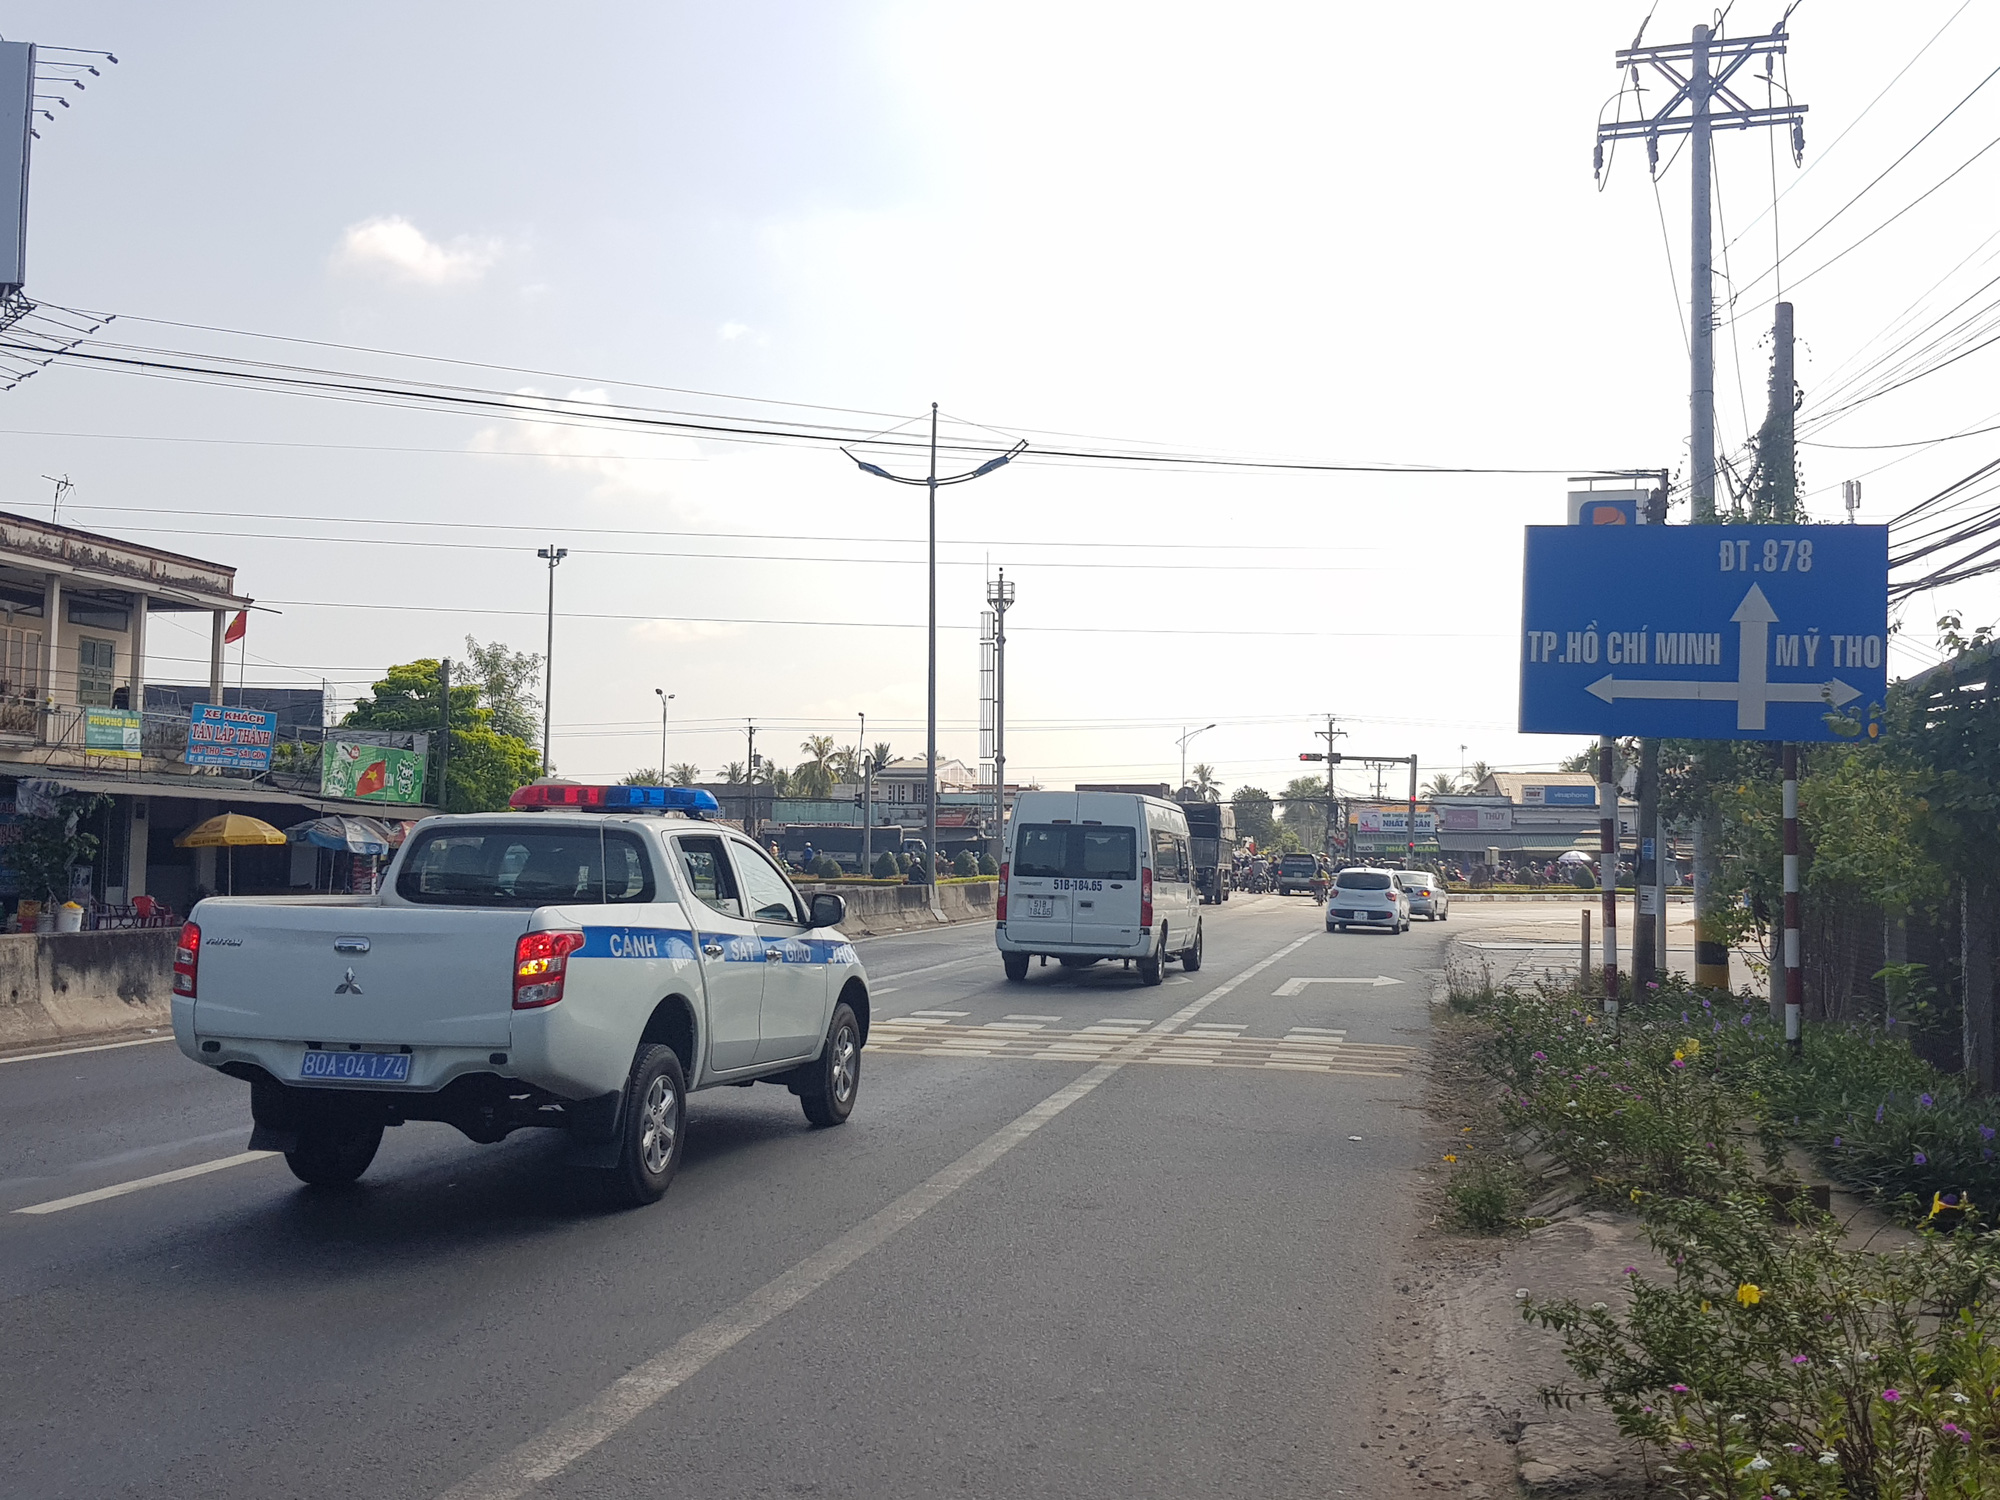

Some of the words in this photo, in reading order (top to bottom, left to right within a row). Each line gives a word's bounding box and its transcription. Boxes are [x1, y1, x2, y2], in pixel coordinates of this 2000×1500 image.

[1719, 539, 1813, 573] ĐT.878
[1528, 620, 1598, 664] TP.HỒ
[1607, 624, 1647, 665] CHÍ
[1655, 632, 1721, 666] MINH
[1776, 627, 1820, 667] MỸ
[1830, 635, 1881, 669] THO
[204, 708, 221, 719] XE
[224, 710, 265, 725] KHÁCH
[1553, 791, 1589, 799] vinaphone
[1053, 879, 1103, 892] 51B-184.65
[1033, 900, 1047, 908] 51B
[206, 938, 243, 947] TRITON
[609, 928, 658, 958] CẢNH
[785, 943, 812, 963] GIAO
[304, 1054, 405, 1078] 80A-041.74
